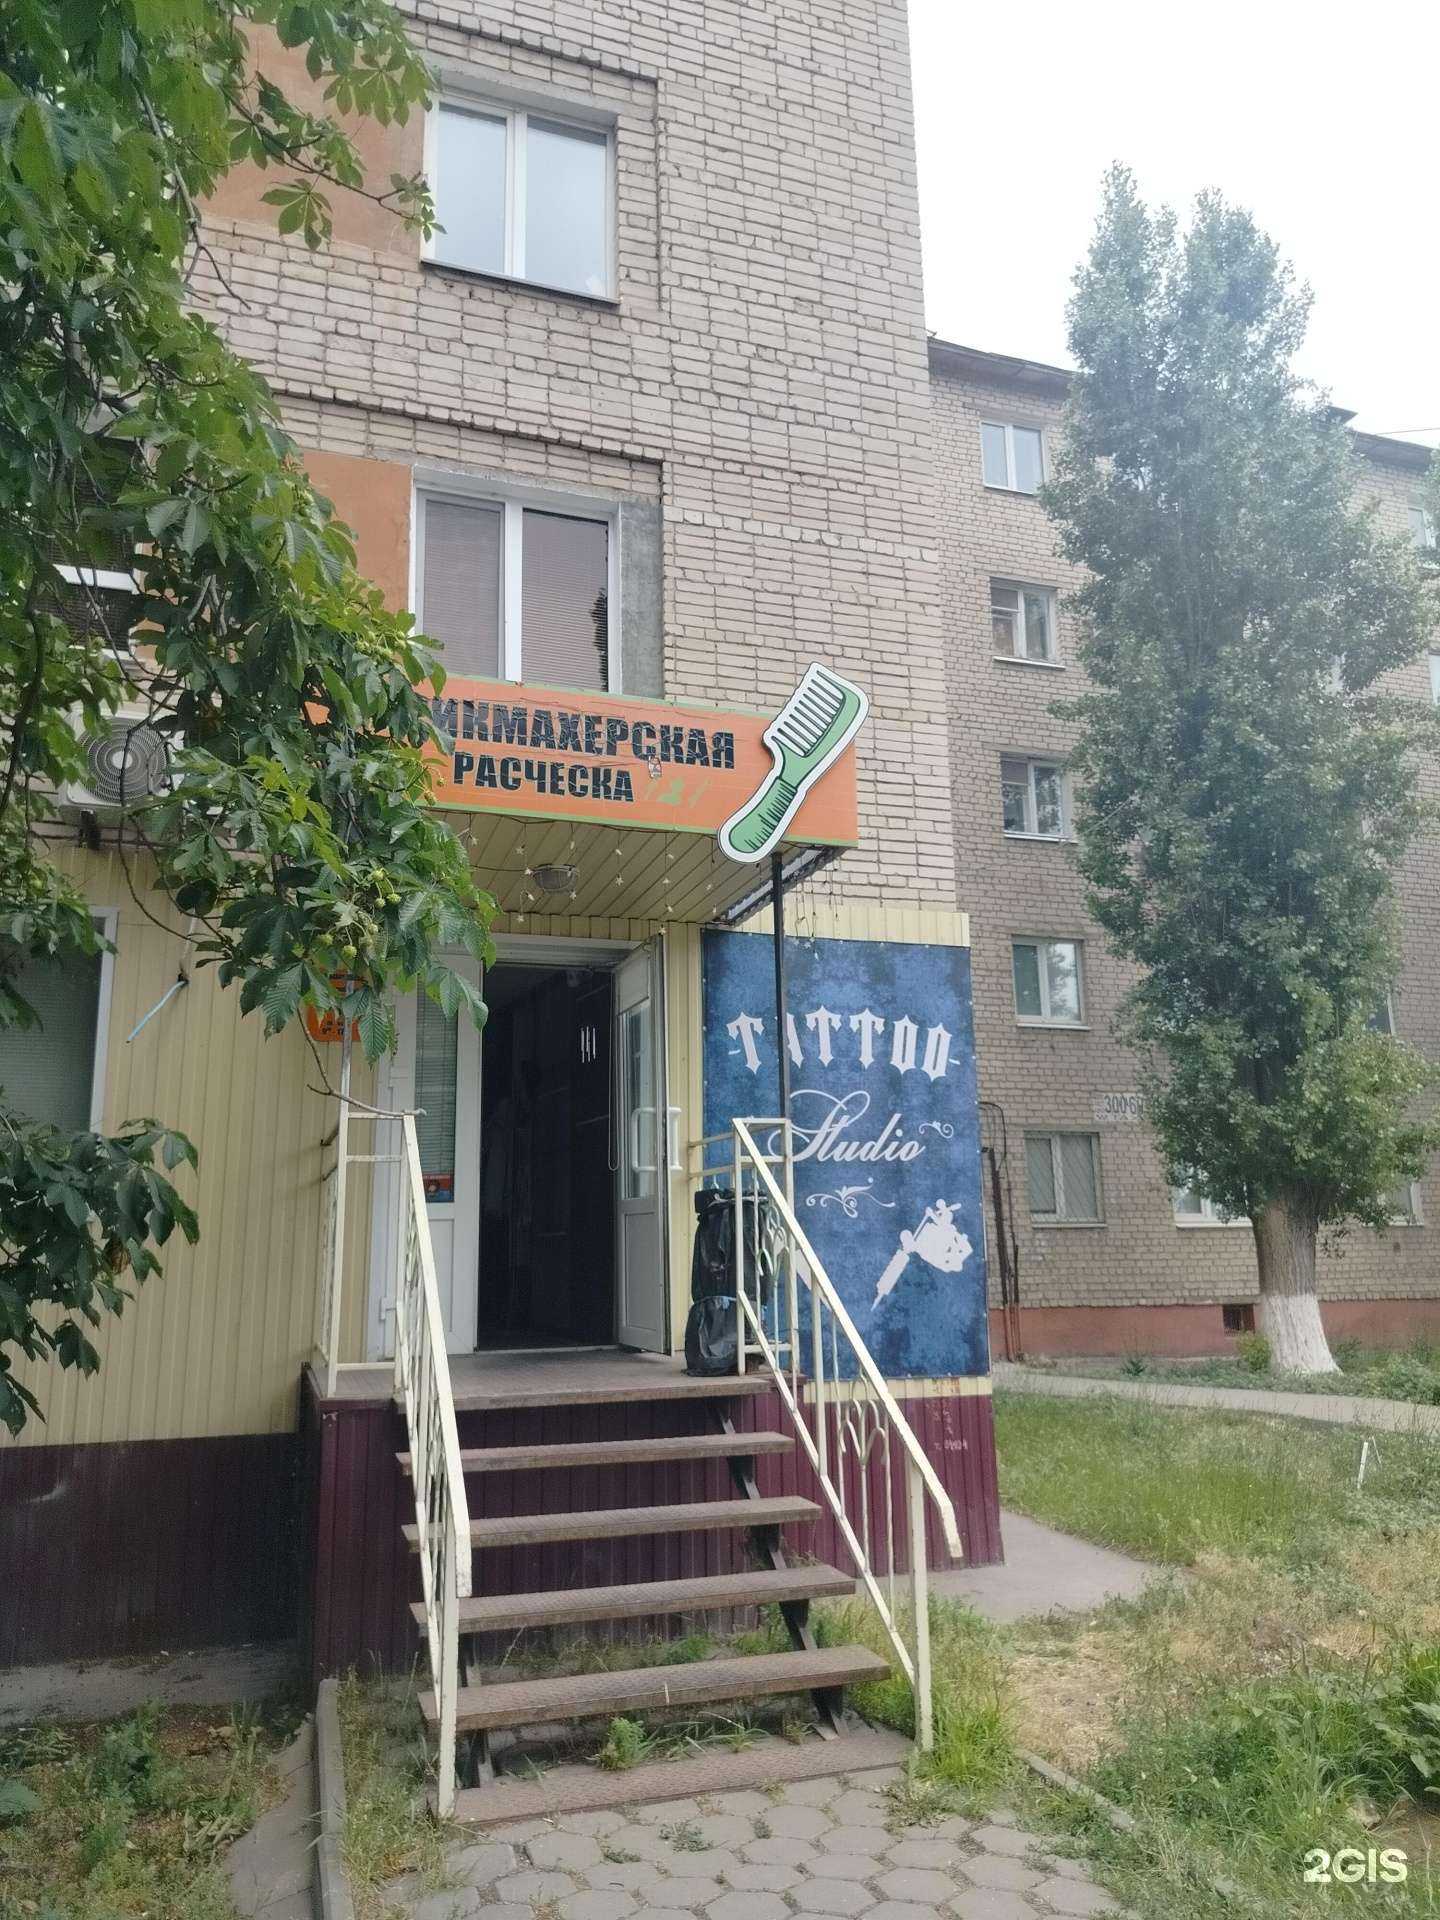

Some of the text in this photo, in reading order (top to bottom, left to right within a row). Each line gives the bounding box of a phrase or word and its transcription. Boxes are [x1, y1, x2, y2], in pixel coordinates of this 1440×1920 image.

[430, 697, 735, 769] ИКМАХЕРСКАЯ
[453, 751, 635, 802] РАСЧЕСКА
[726, 1004, 954, 1083] TATTOO
[767, 1089, 926, 1163] Studio
